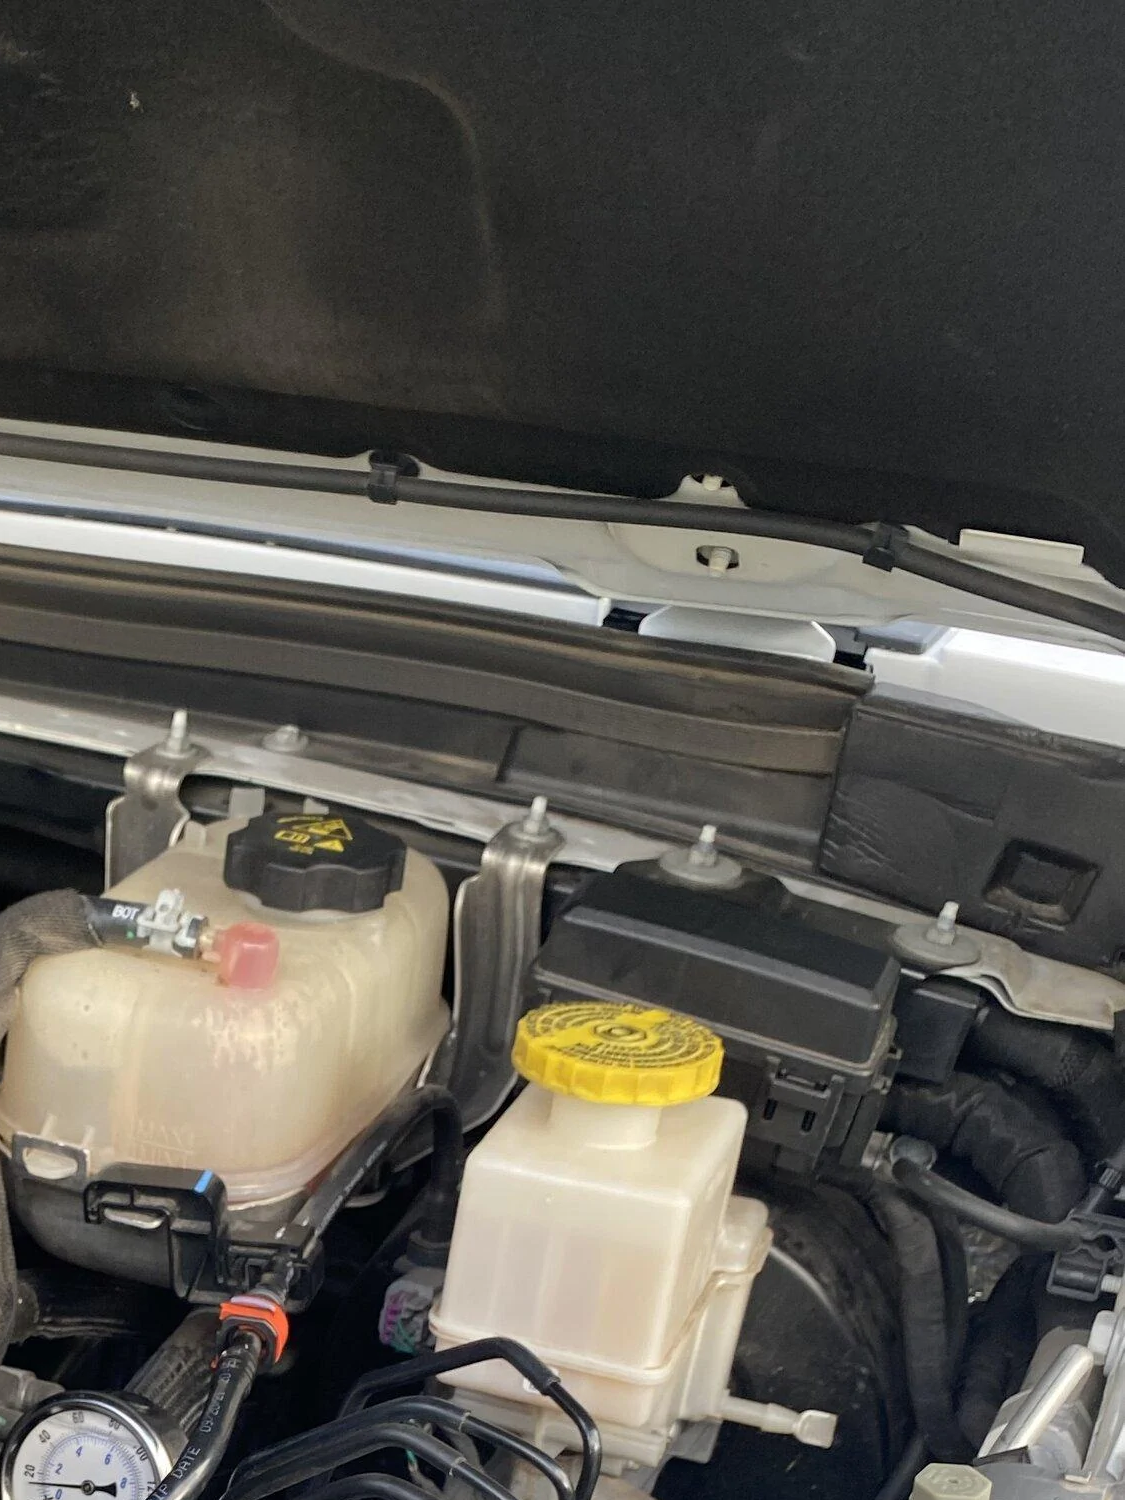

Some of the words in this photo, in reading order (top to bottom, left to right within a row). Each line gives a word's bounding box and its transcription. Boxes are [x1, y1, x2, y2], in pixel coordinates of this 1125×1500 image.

[38, 1429, 52, 1444] 40
[75, 1445, 83, 1458] 4
[104, 1453, 112, 1465] 6
[172, 1446, 201, 1480] DATE
[24, 1464, 36, 1478] 20
[55, 1463, 64, 1475] 2
[119, 1476, 128, 1489] 8
